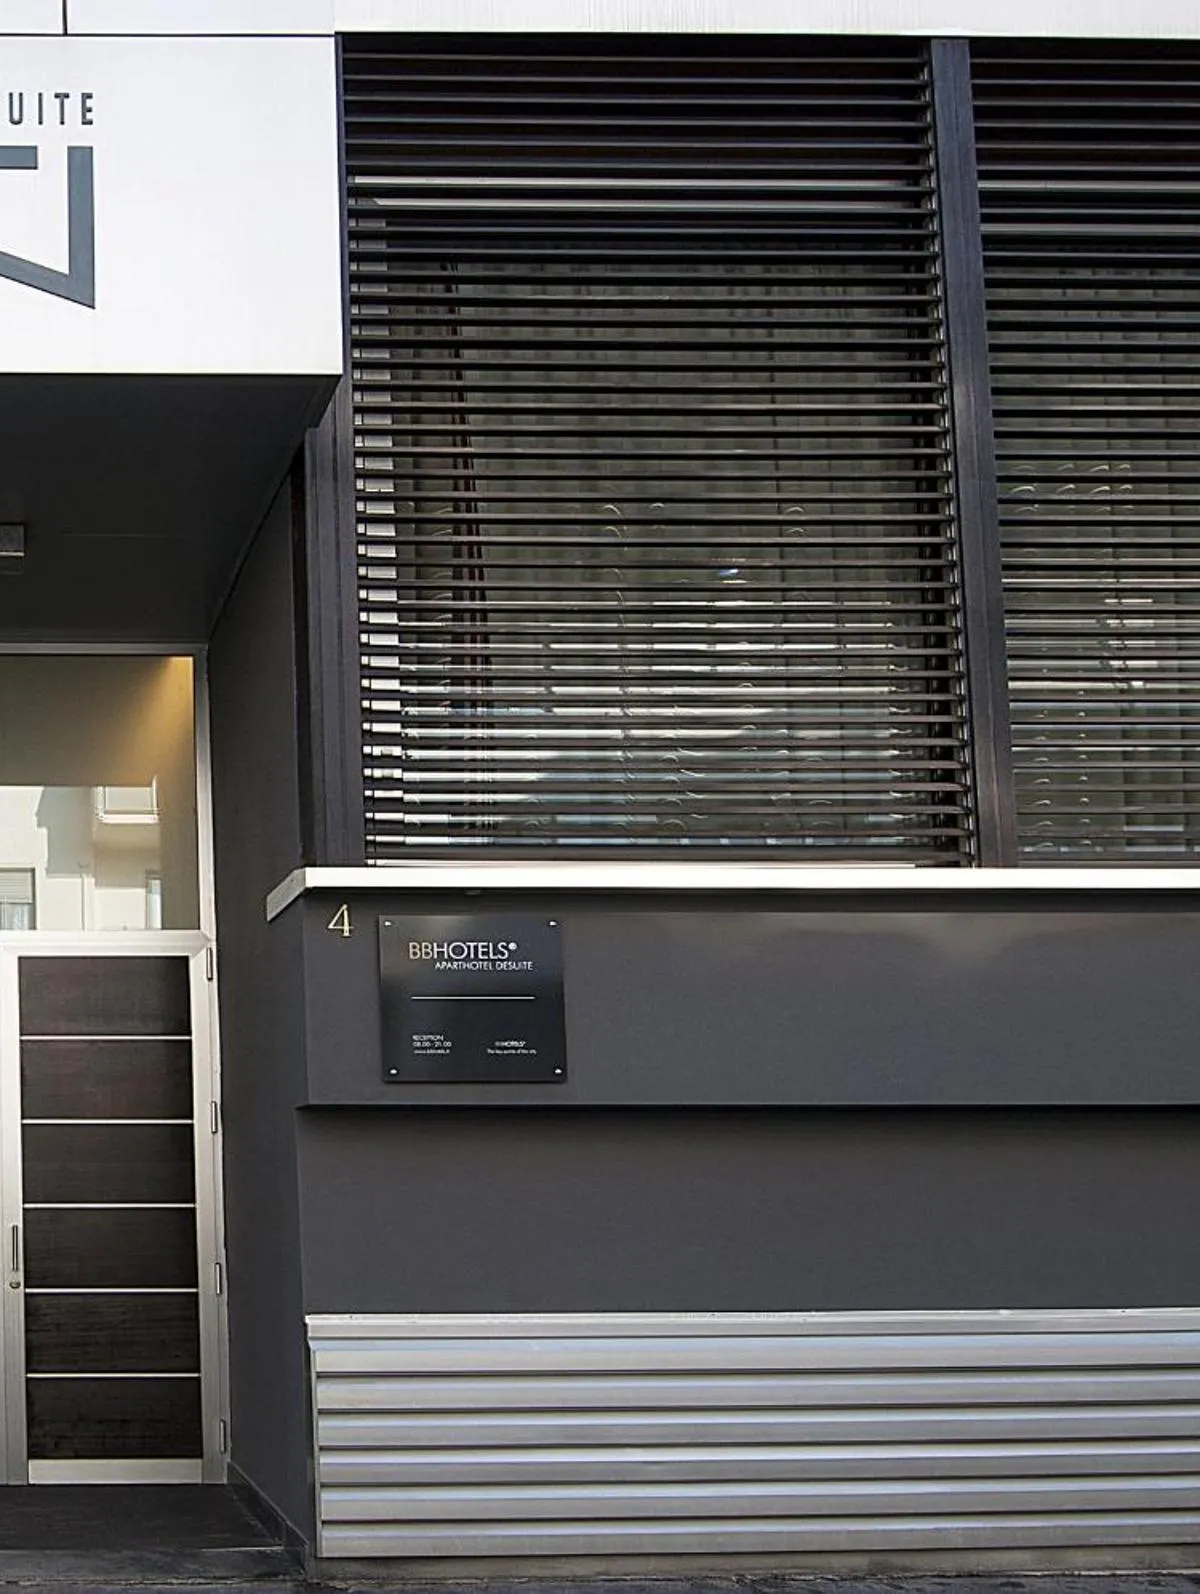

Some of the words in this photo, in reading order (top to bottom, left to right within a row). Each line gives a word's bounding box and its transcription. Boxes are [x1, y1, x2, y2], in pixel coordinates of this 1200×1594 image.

[327, 903, 354, 937] 4
[434, 961, 492, 970] APARTHOTEL
[496, 961, 533, 970] DESUITE
